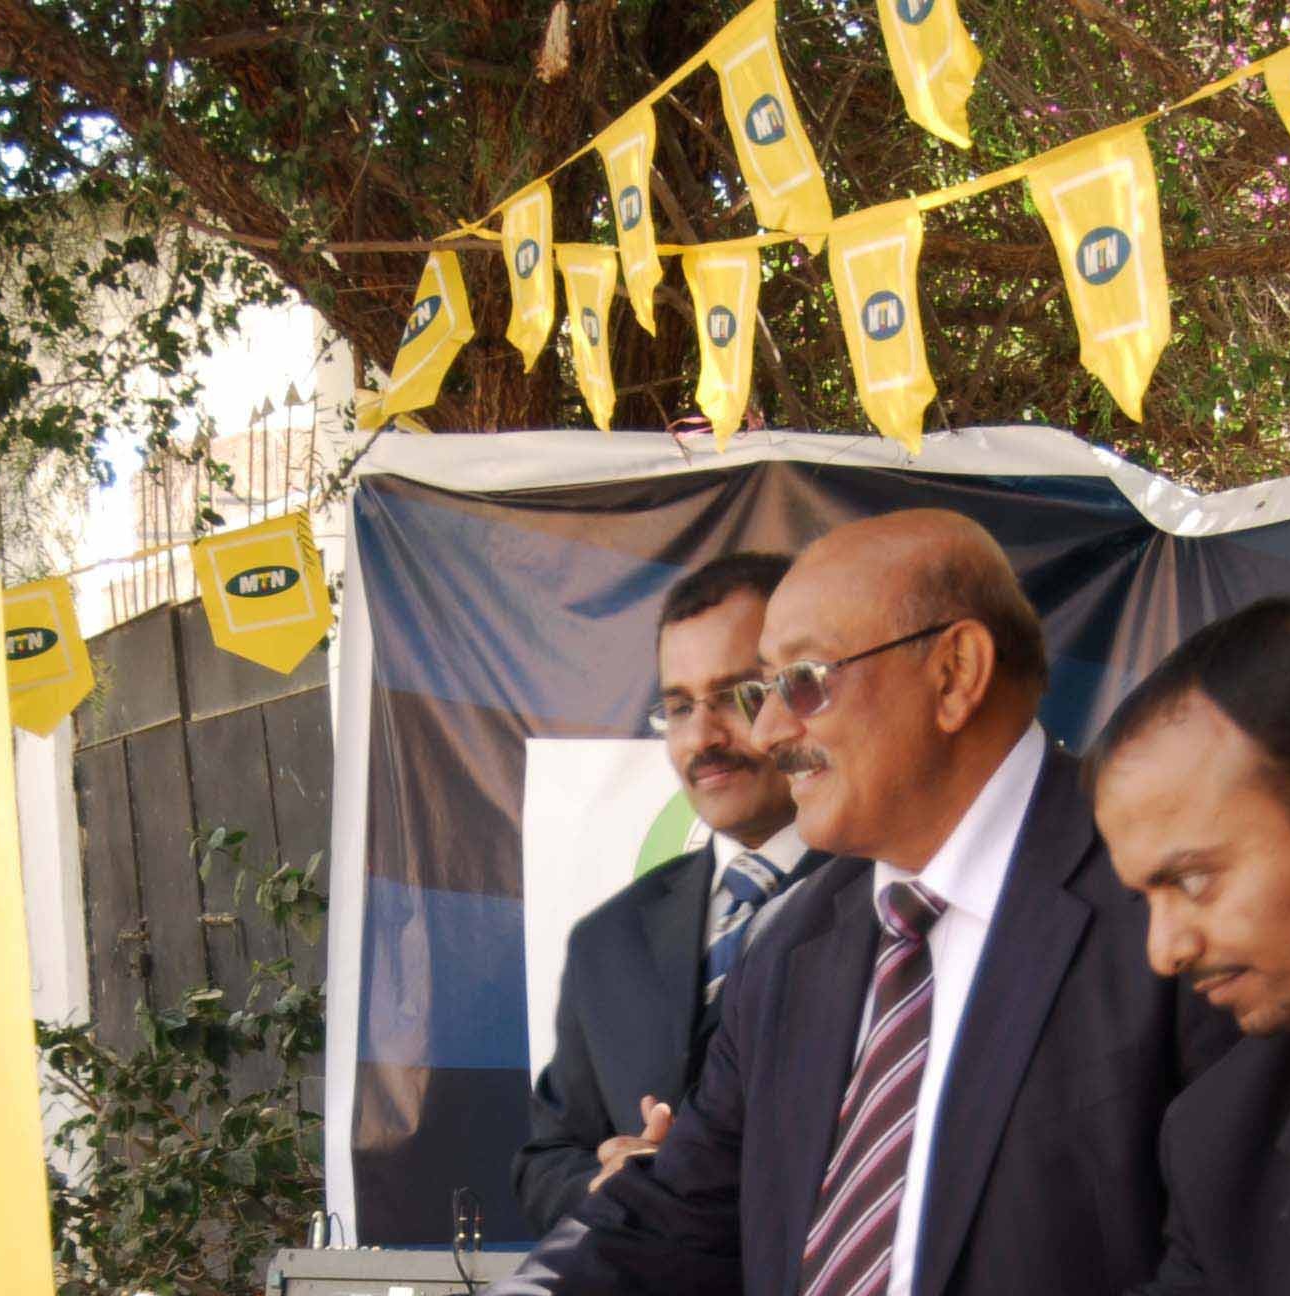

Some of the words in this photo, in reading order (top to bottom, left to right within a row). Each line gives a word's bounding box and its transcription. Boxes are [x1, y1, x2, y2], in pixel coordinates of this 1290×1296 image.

[1083, 235, 1119, 277] MTN
[401, 301, 432, 342] TN
[867, 299, 899, 333] MTN
[239, 569, 286, 595] MTN
